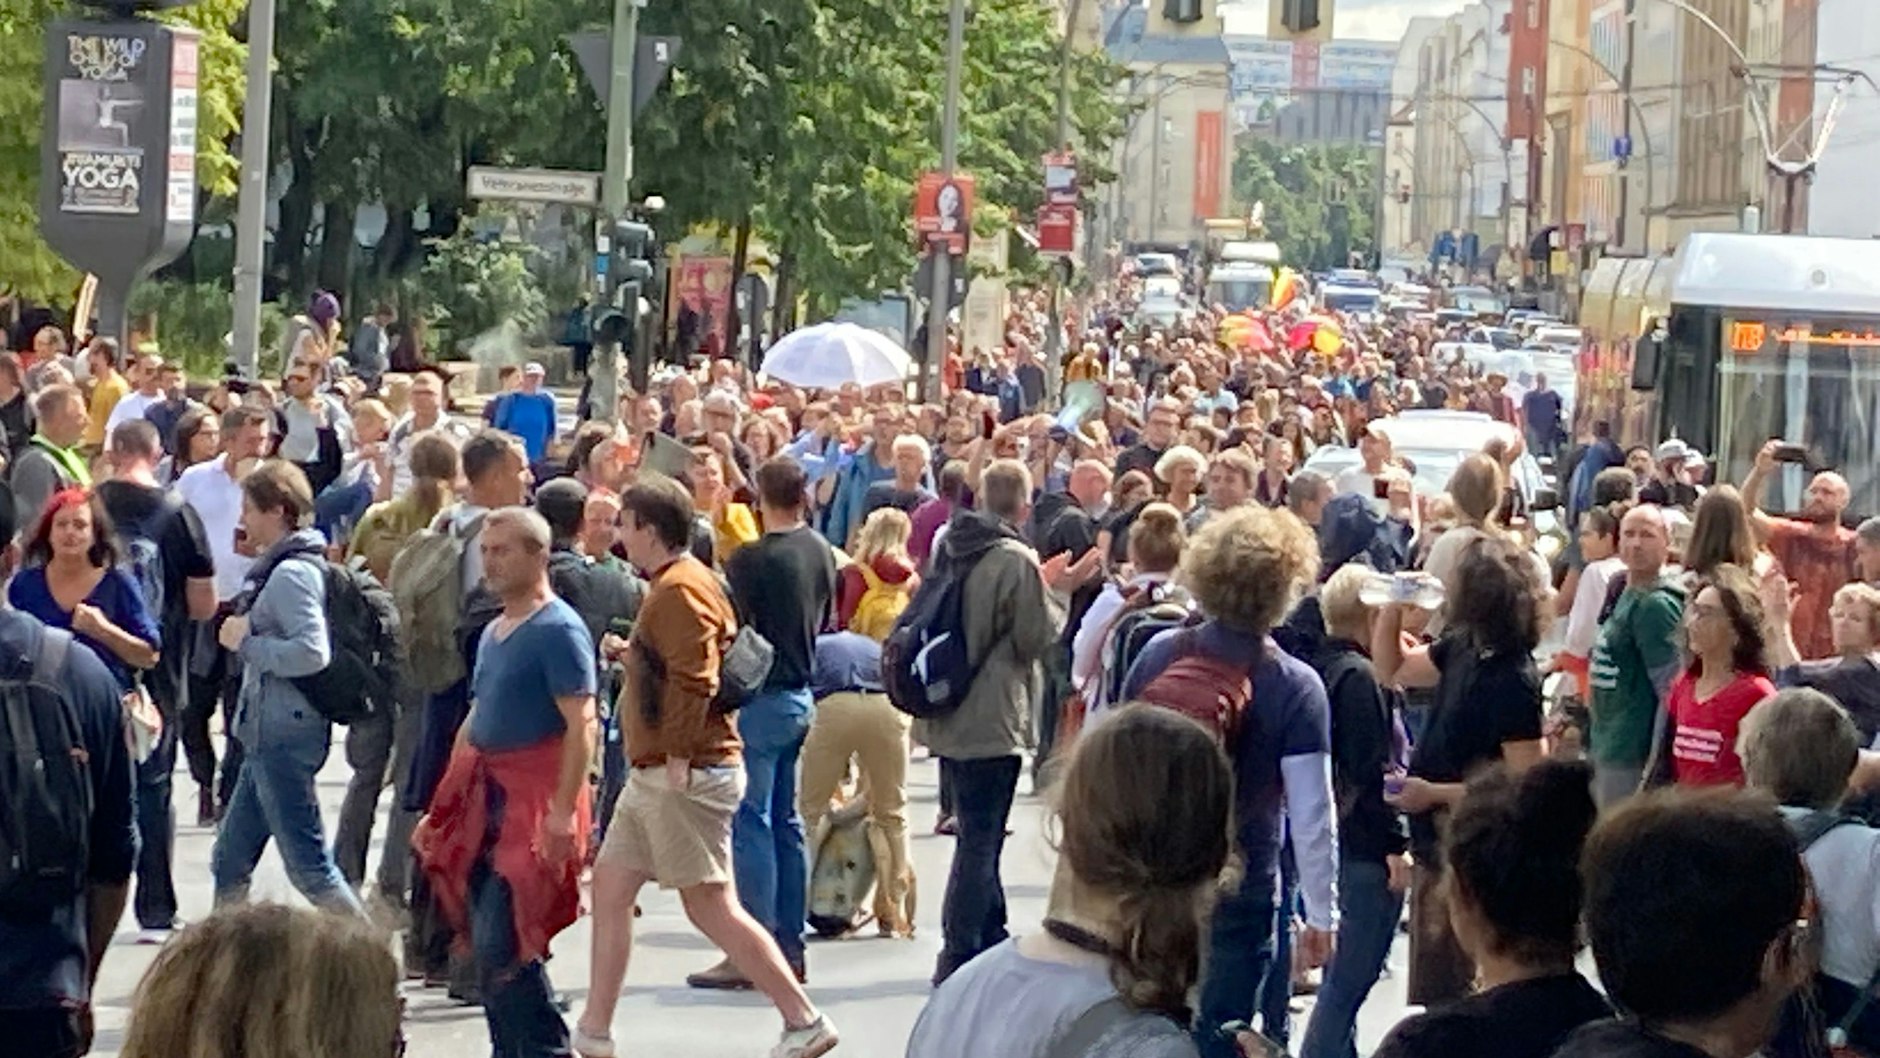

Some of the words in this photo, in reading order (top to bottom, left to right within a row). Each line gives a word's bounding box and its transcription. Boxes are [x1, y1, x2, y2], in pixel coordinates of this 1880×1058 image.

[67, 36, 100, 51] THE
[102, 37, 146, 53] WILD
[80, 65, 128, 80] YOGA
[63, 166, 139, 190] YOGA
